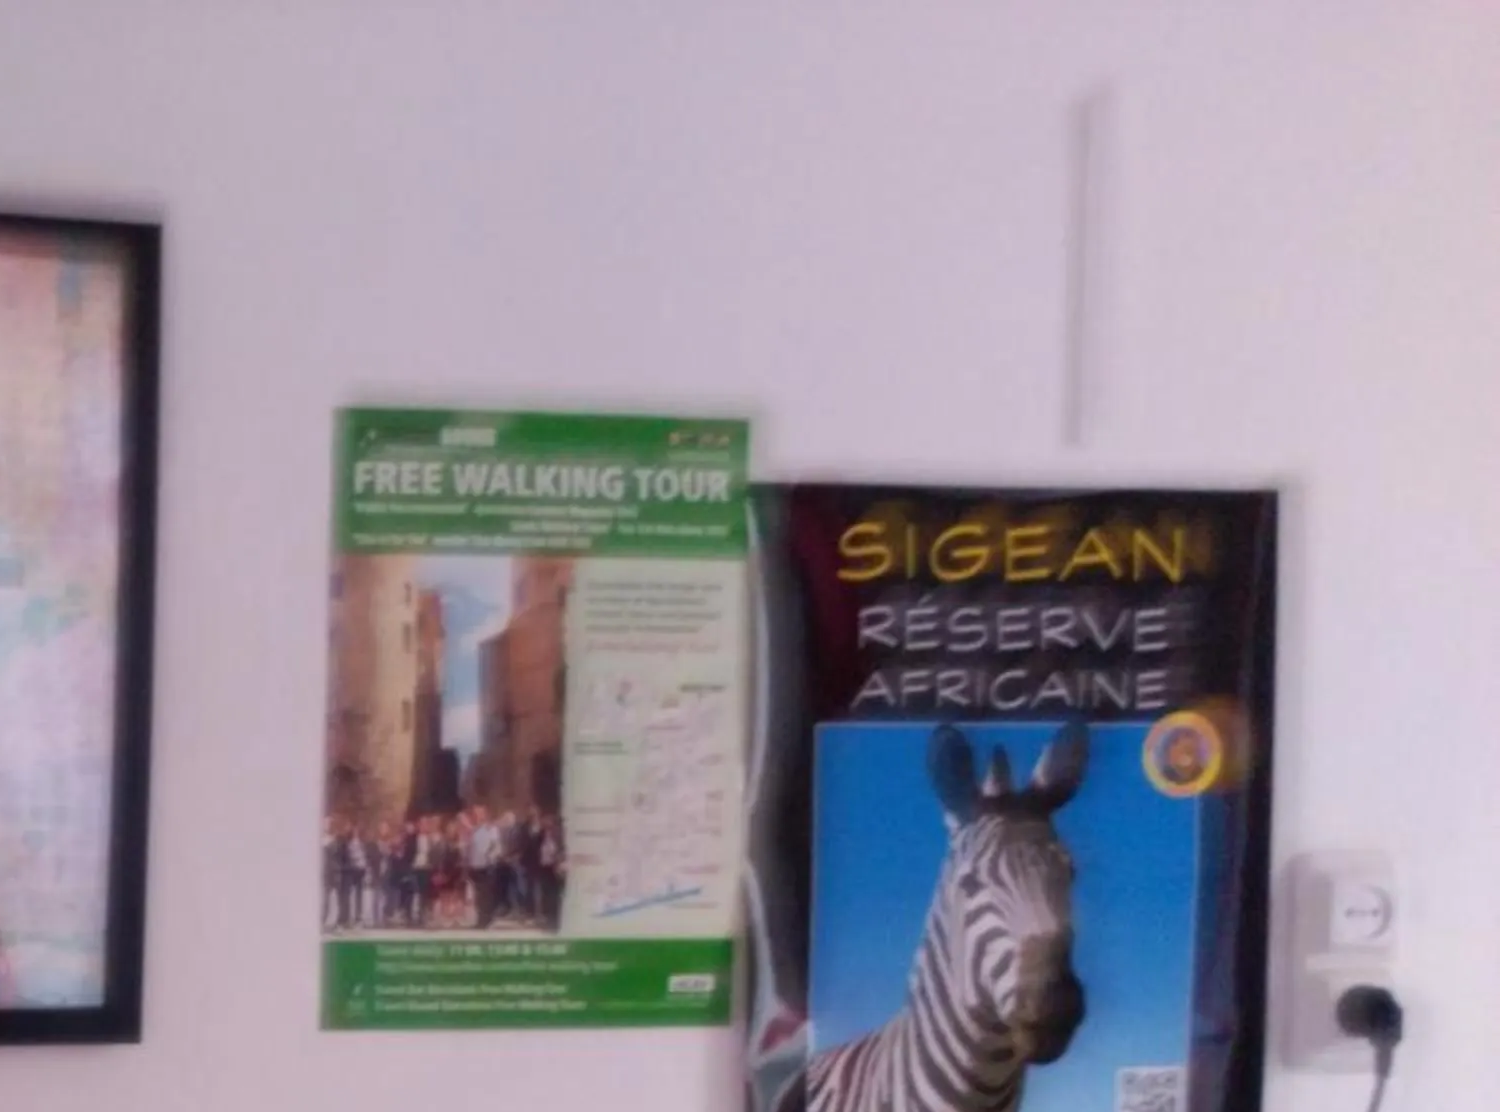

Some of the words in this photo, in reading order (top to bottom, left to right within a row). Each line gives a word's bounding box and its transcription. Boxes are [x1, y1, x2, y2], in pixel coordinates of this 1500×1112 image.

[353, 461, 444, 496] FREE
[452, 462, 626, 500] WALKING
[632, 467, 732, 502] TOUR
[836, 521, 1185, 583] SIGEAN
[857, 594, 1169, 652] RÉSERVE
[850, 668, 1168, 710] AFRICAINE
